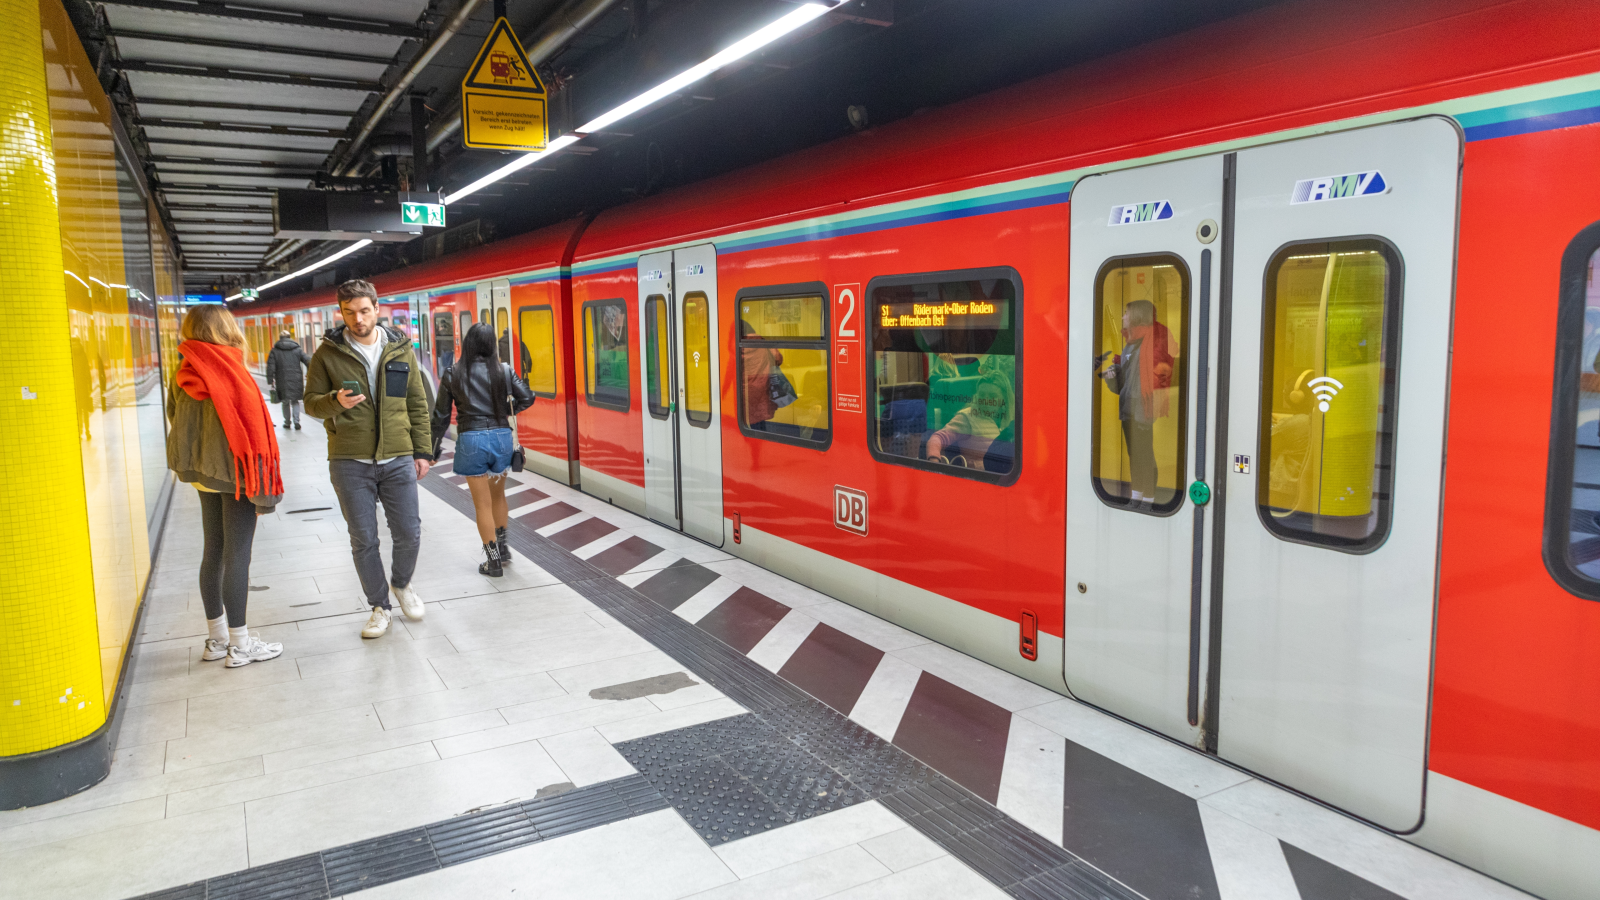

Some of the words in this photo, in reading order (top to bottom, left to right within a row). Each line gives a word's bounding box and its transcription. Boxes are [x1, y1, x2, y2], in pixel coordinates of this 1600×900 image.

[1308, 172, 1377, 201] RMV
[1119, 200, 1168, 224] RMV
[838, 288, 856, 337] 2
[881, 305, 889, 316] S1
[913, 302, 968, 316] Rödermark-Ober
[970, 301, 994, 314] Roden
[881, 316, 898, 327] über:
[899, 314, 932, 327] Offenbach
[932, 314, 945, 327] Ost
[838, 492, 864, 528] DB
